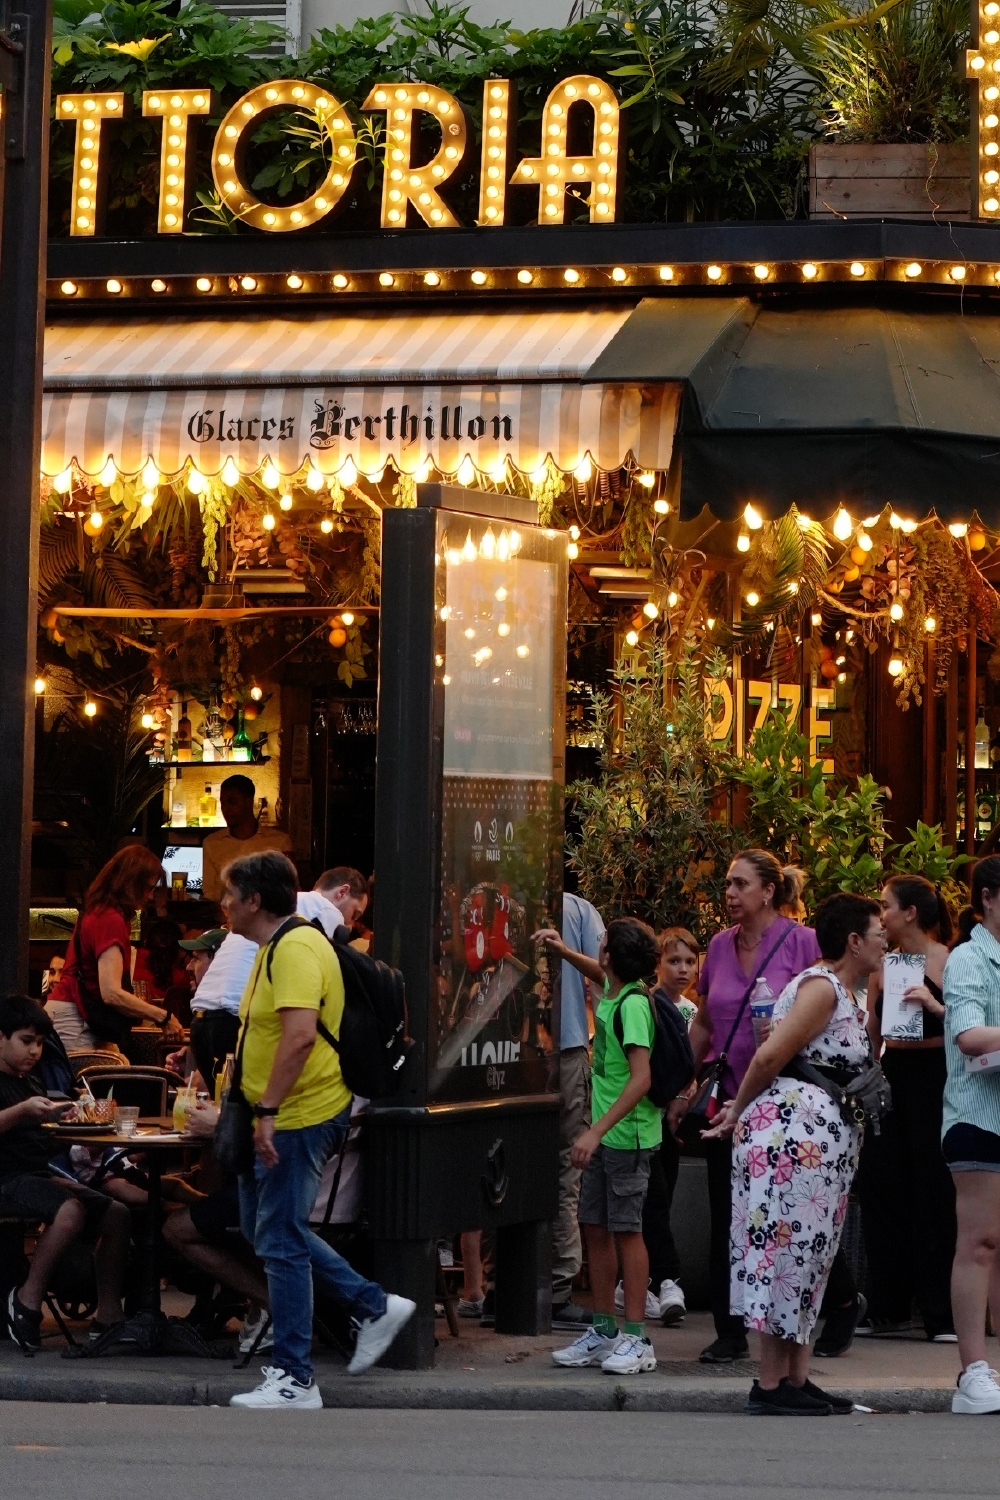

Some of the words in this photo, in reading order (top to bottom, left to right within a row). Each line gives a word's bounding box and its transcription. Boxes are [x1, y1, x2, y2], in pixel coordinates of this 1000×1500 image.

[56, 74, 622, 236] TTORIA
[187, 407, 295, 443] Glaces
[309, 399, 515, 450] Berthillon
[486, 849, 501, 862] PARIS
